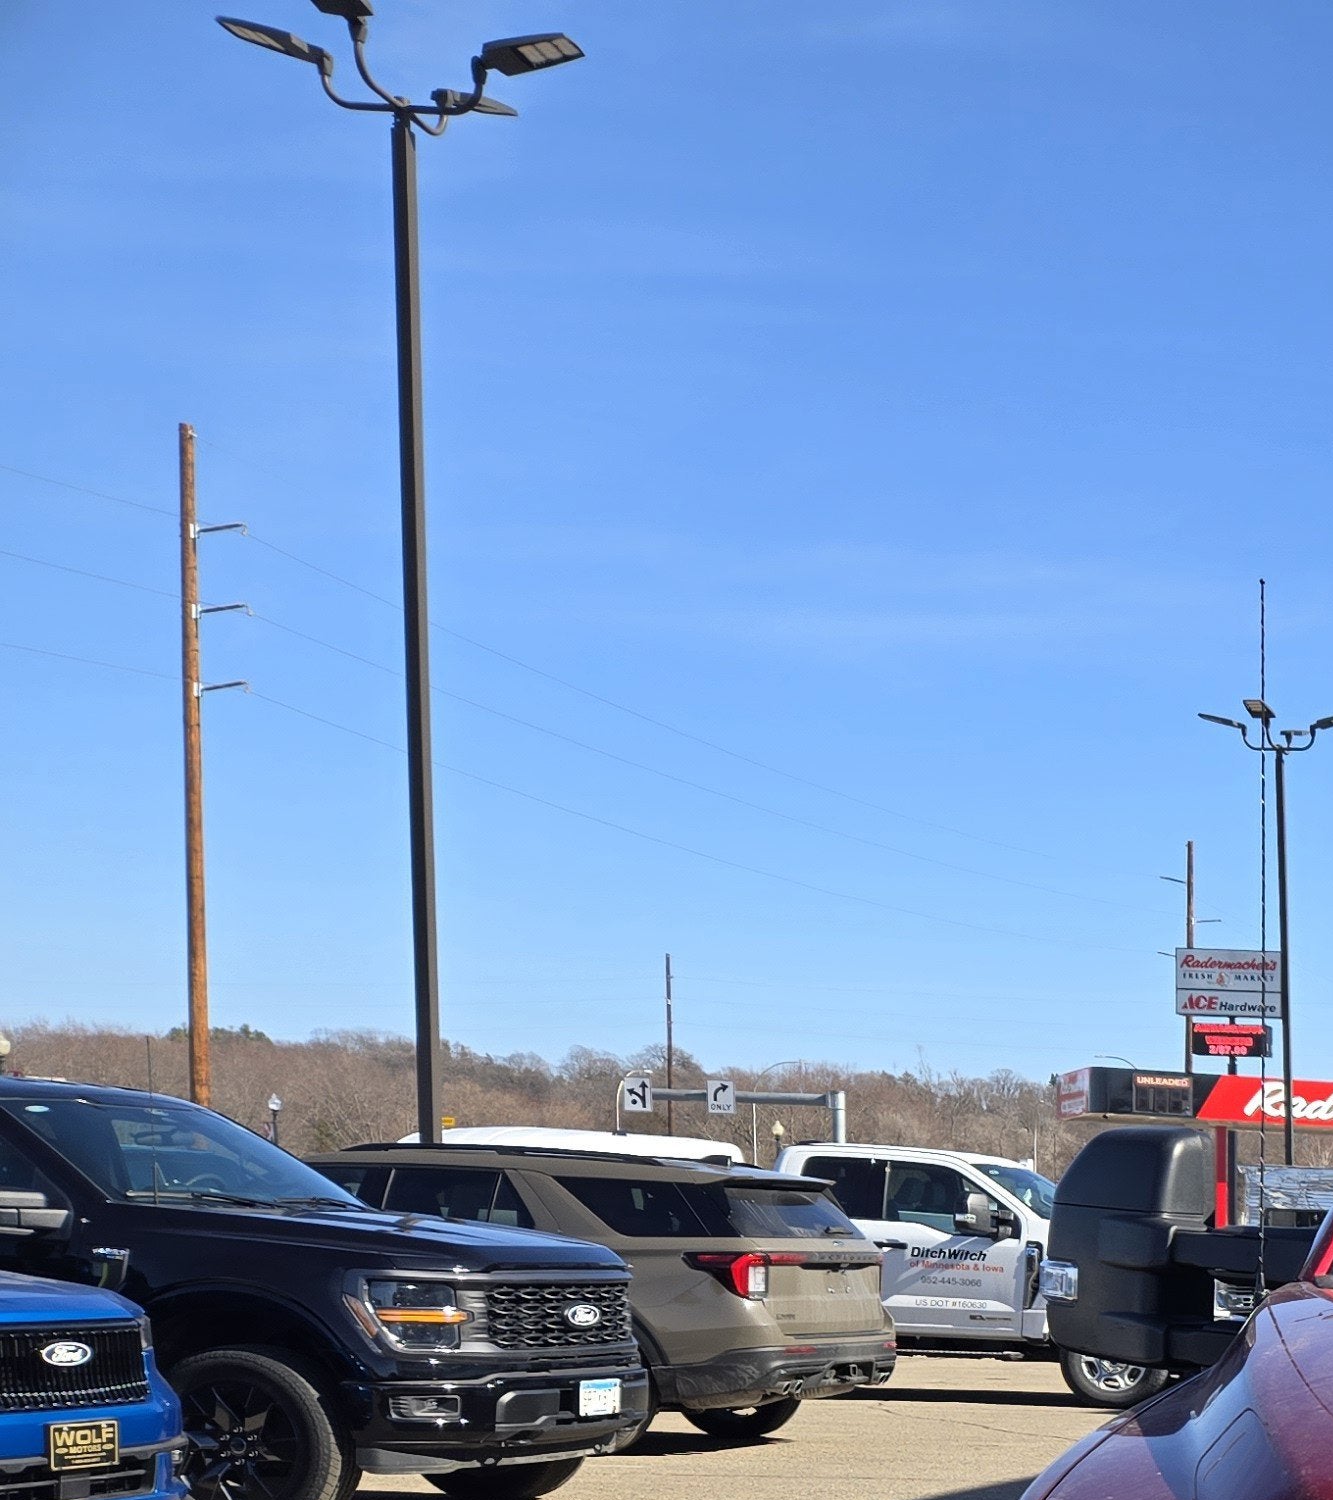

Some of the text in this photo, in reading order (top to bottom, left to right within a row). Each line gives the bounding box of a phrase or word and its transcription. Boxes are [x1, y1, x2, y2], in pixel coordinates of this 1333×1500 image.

[1180, 954, 1277, 971] Radermacher's
[1183, 972, 1213, 980] FRESH
[1181, 993, 1277, 1012] ACE Hardware
[1136, 1076, 1188, 1086] UNLEADED
[710, 1103, 732, 1111] ONLY
[909, 1259, 1004, 1273] of Minnesota & Iowa
[915, 1299, 928, 1307] US
[930, 1300, 949, 1308] DOT
[52, 1344, 83, 1362] Ford
[54, 1427, 114, 1447] WOLF
[68, 1443, 102, 1455] MOTORS
